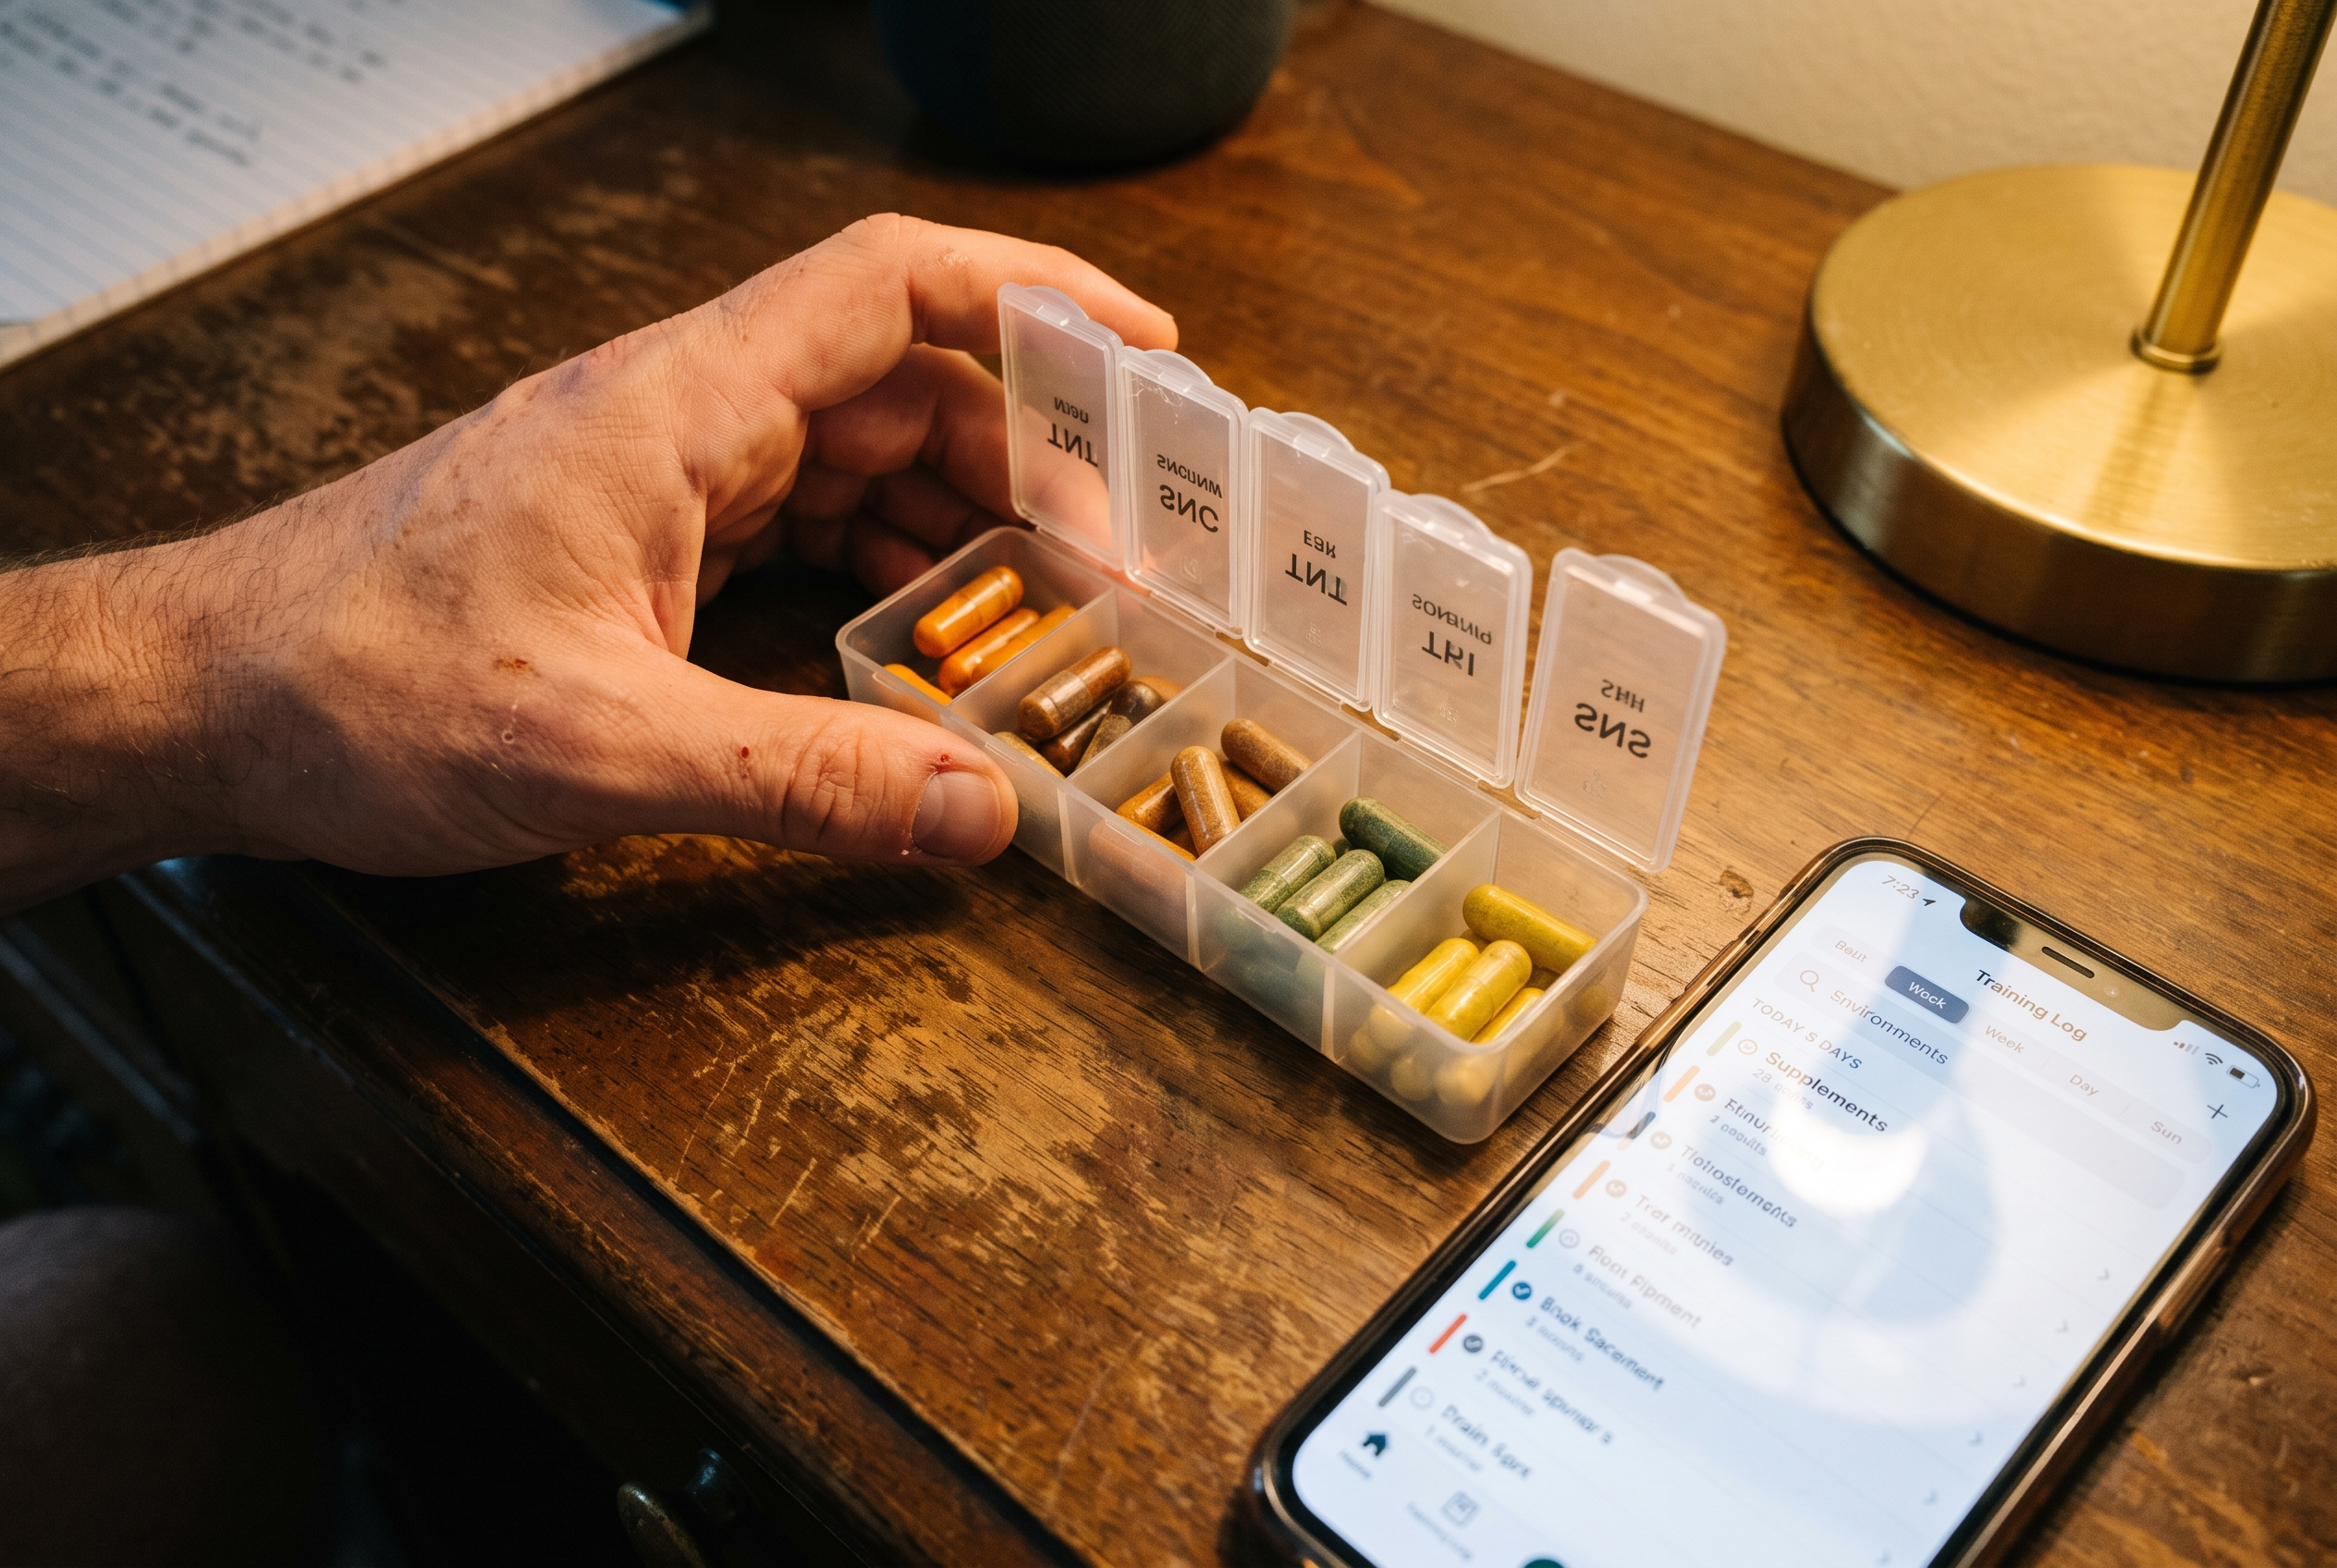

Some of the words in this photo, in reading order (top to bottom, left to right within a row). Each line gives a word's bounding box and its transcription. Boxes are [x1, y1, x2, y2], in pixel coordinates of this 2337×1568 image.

[1881, 875, 1920, 900] 7:23
[1752, 998, 1806, 1035] TODAY
[1818, 1039, 1863, 1070] DAYS
[1976, 969, 2049, 1021] Training
[2049, 1013, 2088, 1042] Log
[1766, 1051, 1889, 1133] Supplements
[1985, 1024, 2025, 1055] Week
[2069, 1074, 2099, 1097] Day
[2150, 1121, 2184, 1145] Sun
